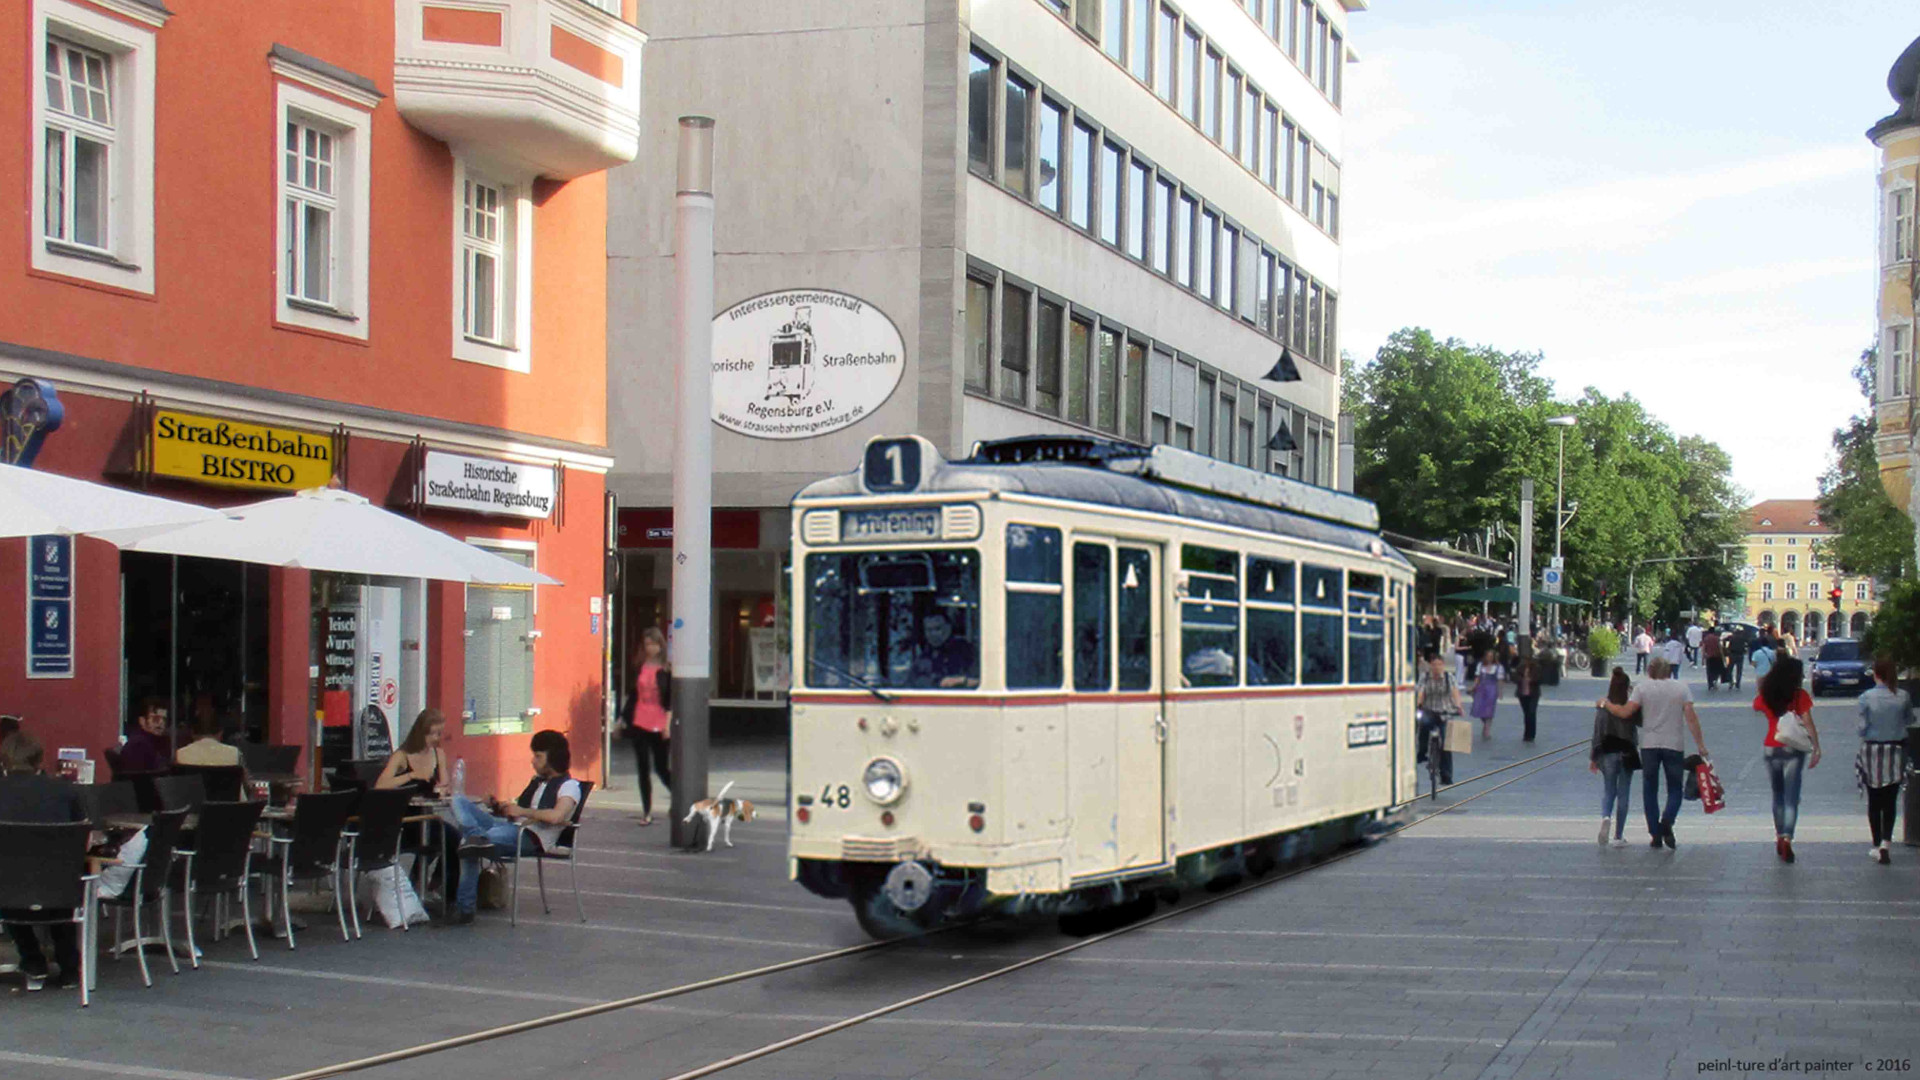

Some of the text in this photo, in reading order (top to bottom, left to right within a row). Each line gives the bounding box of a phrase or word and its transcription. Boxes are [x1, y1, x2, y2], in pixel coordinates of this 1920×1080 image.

[729, 293, 863, 321] Interessengemeinschaft
[712, 352, 896, 372] orische Straßenbahn
[747, 400, 835, 420] Regensburg e.V.
[158, 416, 328, 460] Straßenbahn
[202, 454, 295, 484] BISTRO
[464, 463, 517, 484] Historische
[884, 444, 904, 485] 1
[429, 481, 549, 512] Straßenbahn Regensburg
[328, 617, 356, 631] leisch
[820, 784, 851, 809] 48
